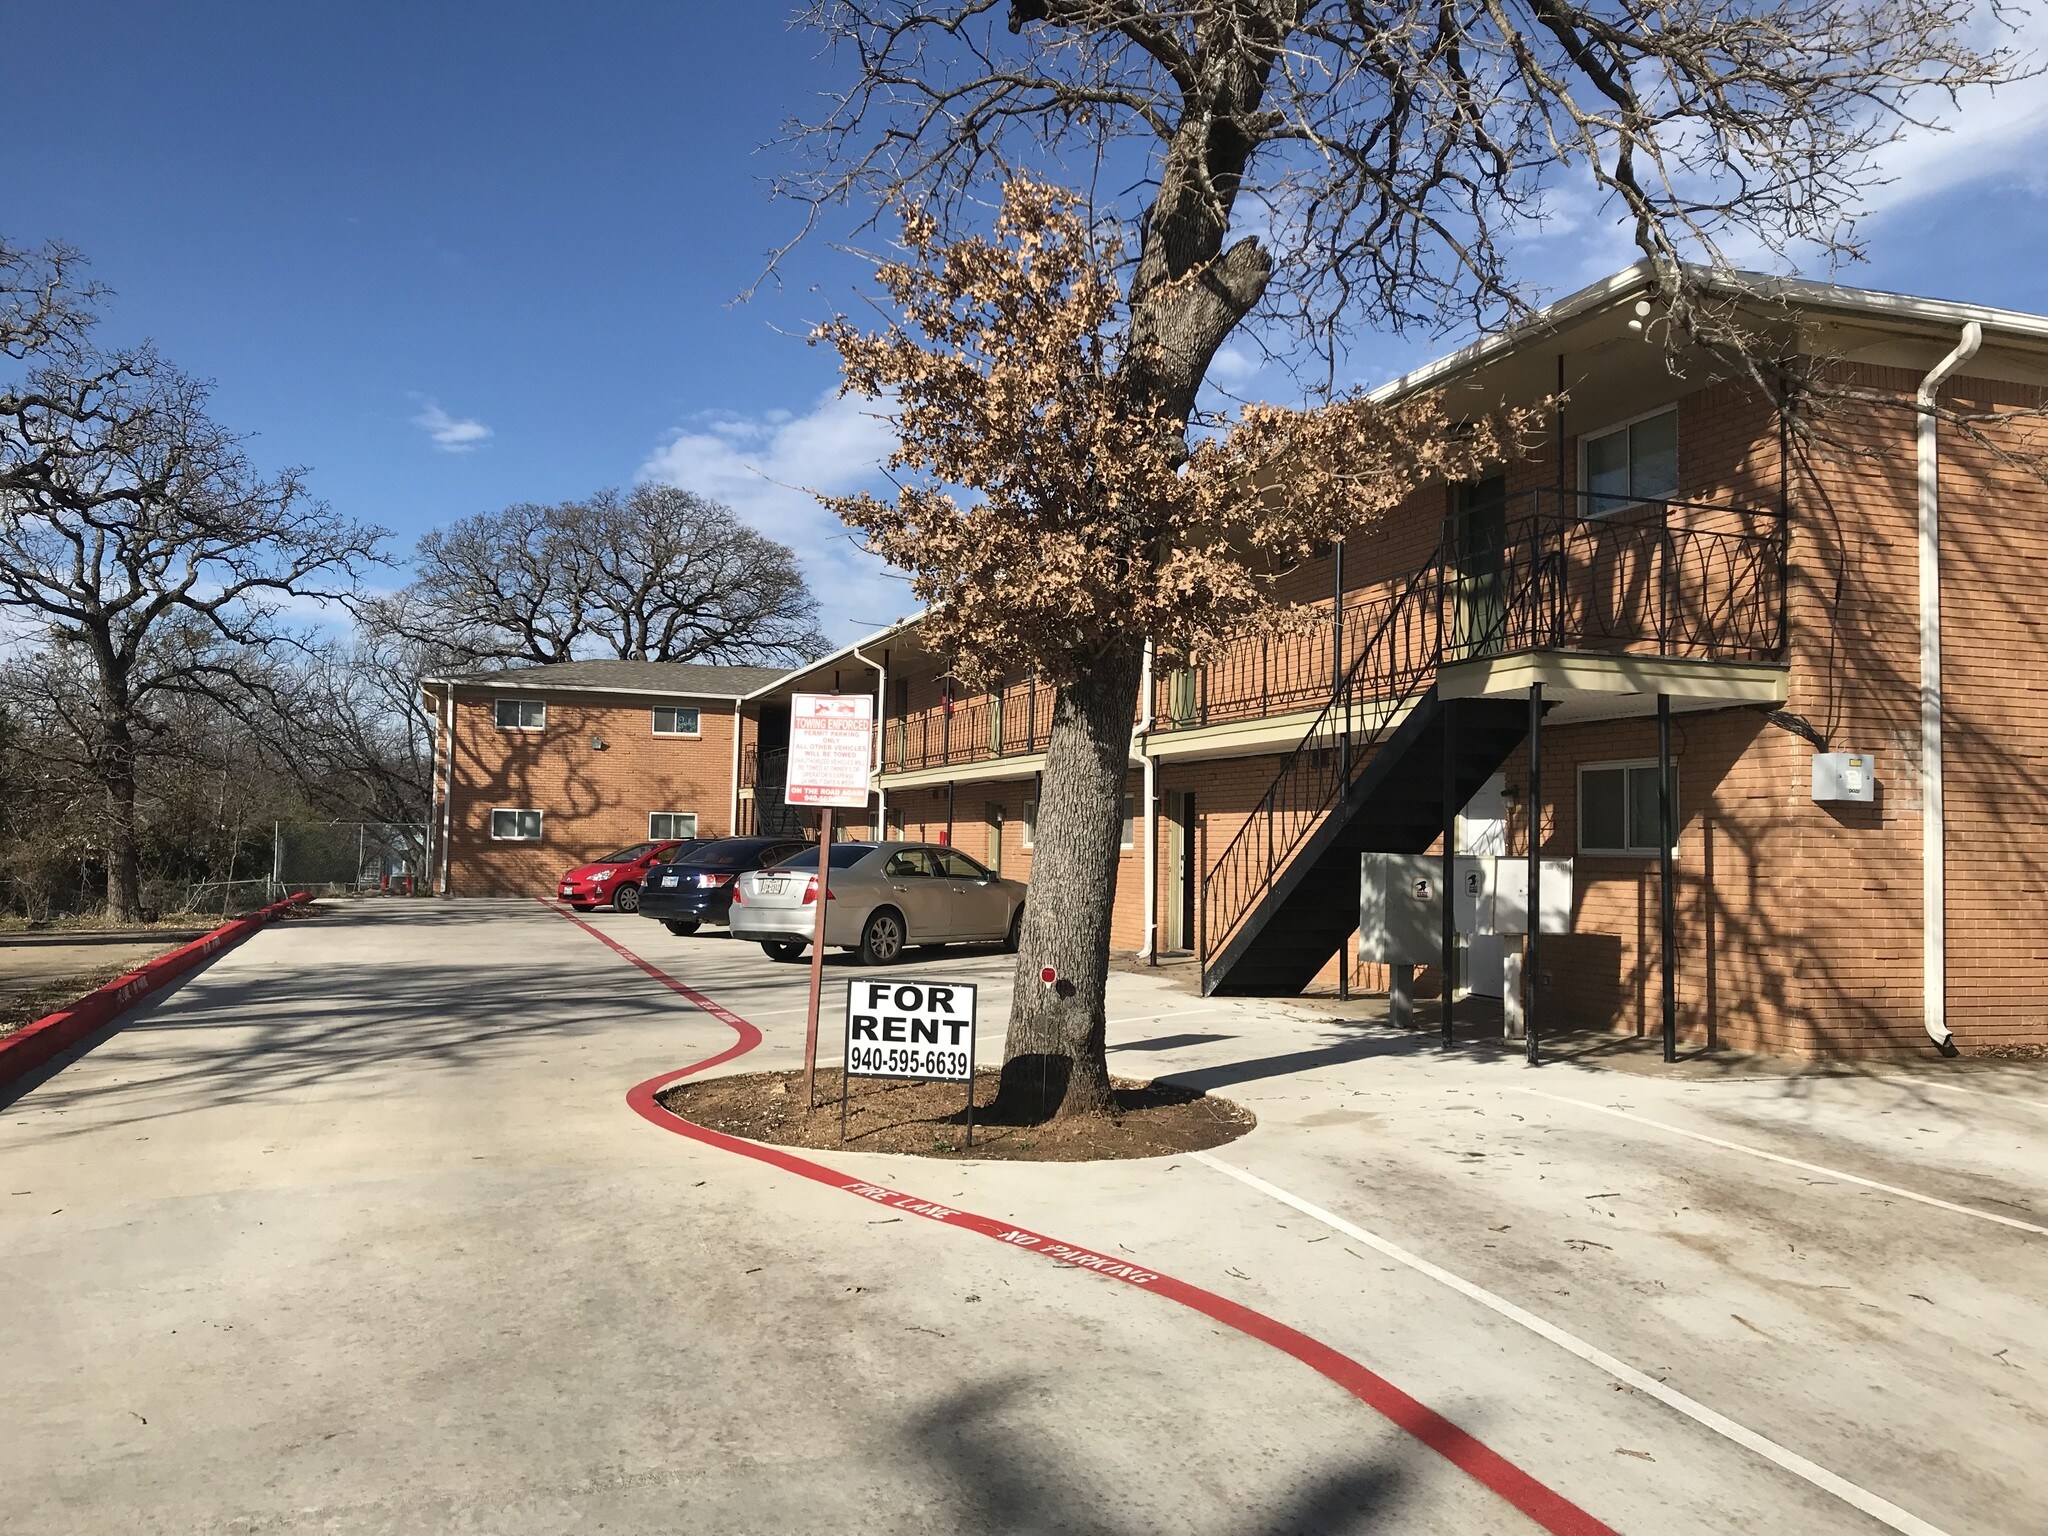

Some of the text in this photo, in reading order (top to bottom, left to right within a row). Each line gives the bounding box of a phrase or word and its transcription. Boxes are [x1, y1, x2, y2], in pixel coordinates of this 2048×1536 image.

[797, 718, 869, 731] TOWING ENFORCED
[868, 984, 955, 1014] FOR
[852, 1015, 969, 1046] RENT
[851, 1047, 967, 1076] 940-595-6639
[841, 1183, 962, 1219] FIRE LANE
[997, 1230, 1158, 1283] NO PARKING
